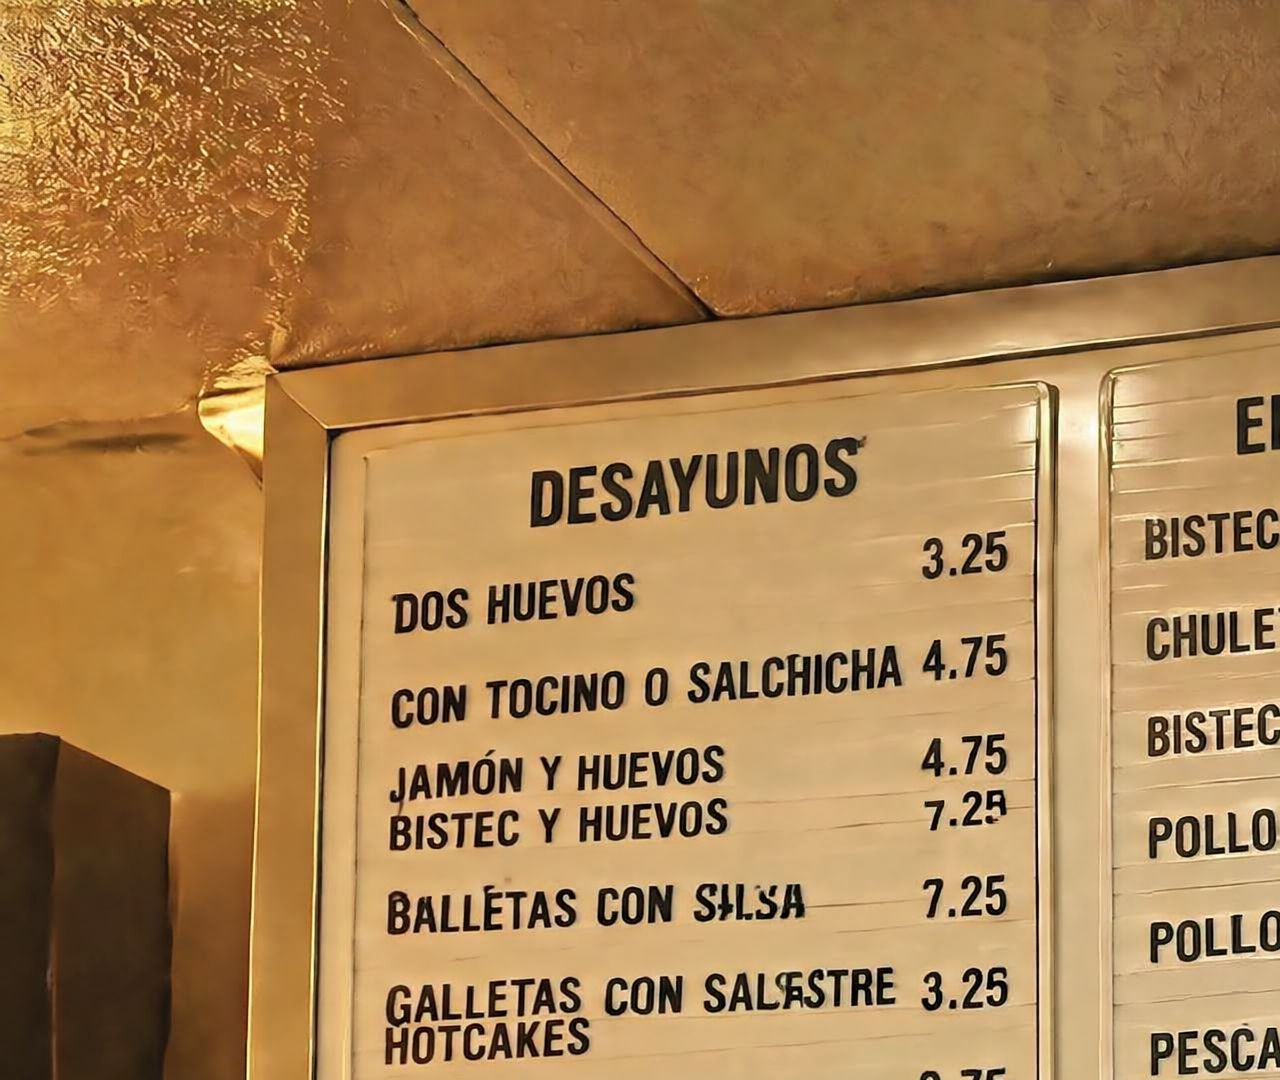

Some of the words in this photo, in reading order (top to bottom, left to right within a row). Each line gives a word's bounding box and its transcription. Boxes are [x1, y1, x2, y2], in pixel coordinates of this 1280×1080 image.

[530, 436, 866, 528] DESAYUNOS
[1145, 508, 1280, 561] BISTEC
[391, 587, 469, 635] DOS
[487, 572, 635, 625] HUEVOS
[922, 530, 1009, 580] 3.25
[391, 684, 467, 729] CON
[485, 670, 626, 719] TOCINO
[644, 667, 669, 707] O
[687, 645, 903, 704] SALCHICHA
[922, 633, 1008, 681] 4.75
[389, 749, 523, 803] JAMÓN
[540, 755, 562, 791] Y
[577, 744, 725, 791] HUEVOS
[921, 733, 1008, 778] 4.75
[389, 809, 520, 851] BISTEC
[538, 807, 561, 844] Y
[579, 797, 728, 843] HUEVOS
[1148, 808, 1277, 860] POLLO
[596, 884, 674, 927] CON
[922, 874, 1007, 919] 7.25
[385, 976, 582, 1028] GALLETAS
[604, 975, 683, 1017] CON
[921, 966, 1009, 1012] 3.25
[385, 1017, 590, 1065] HOTCAKES
